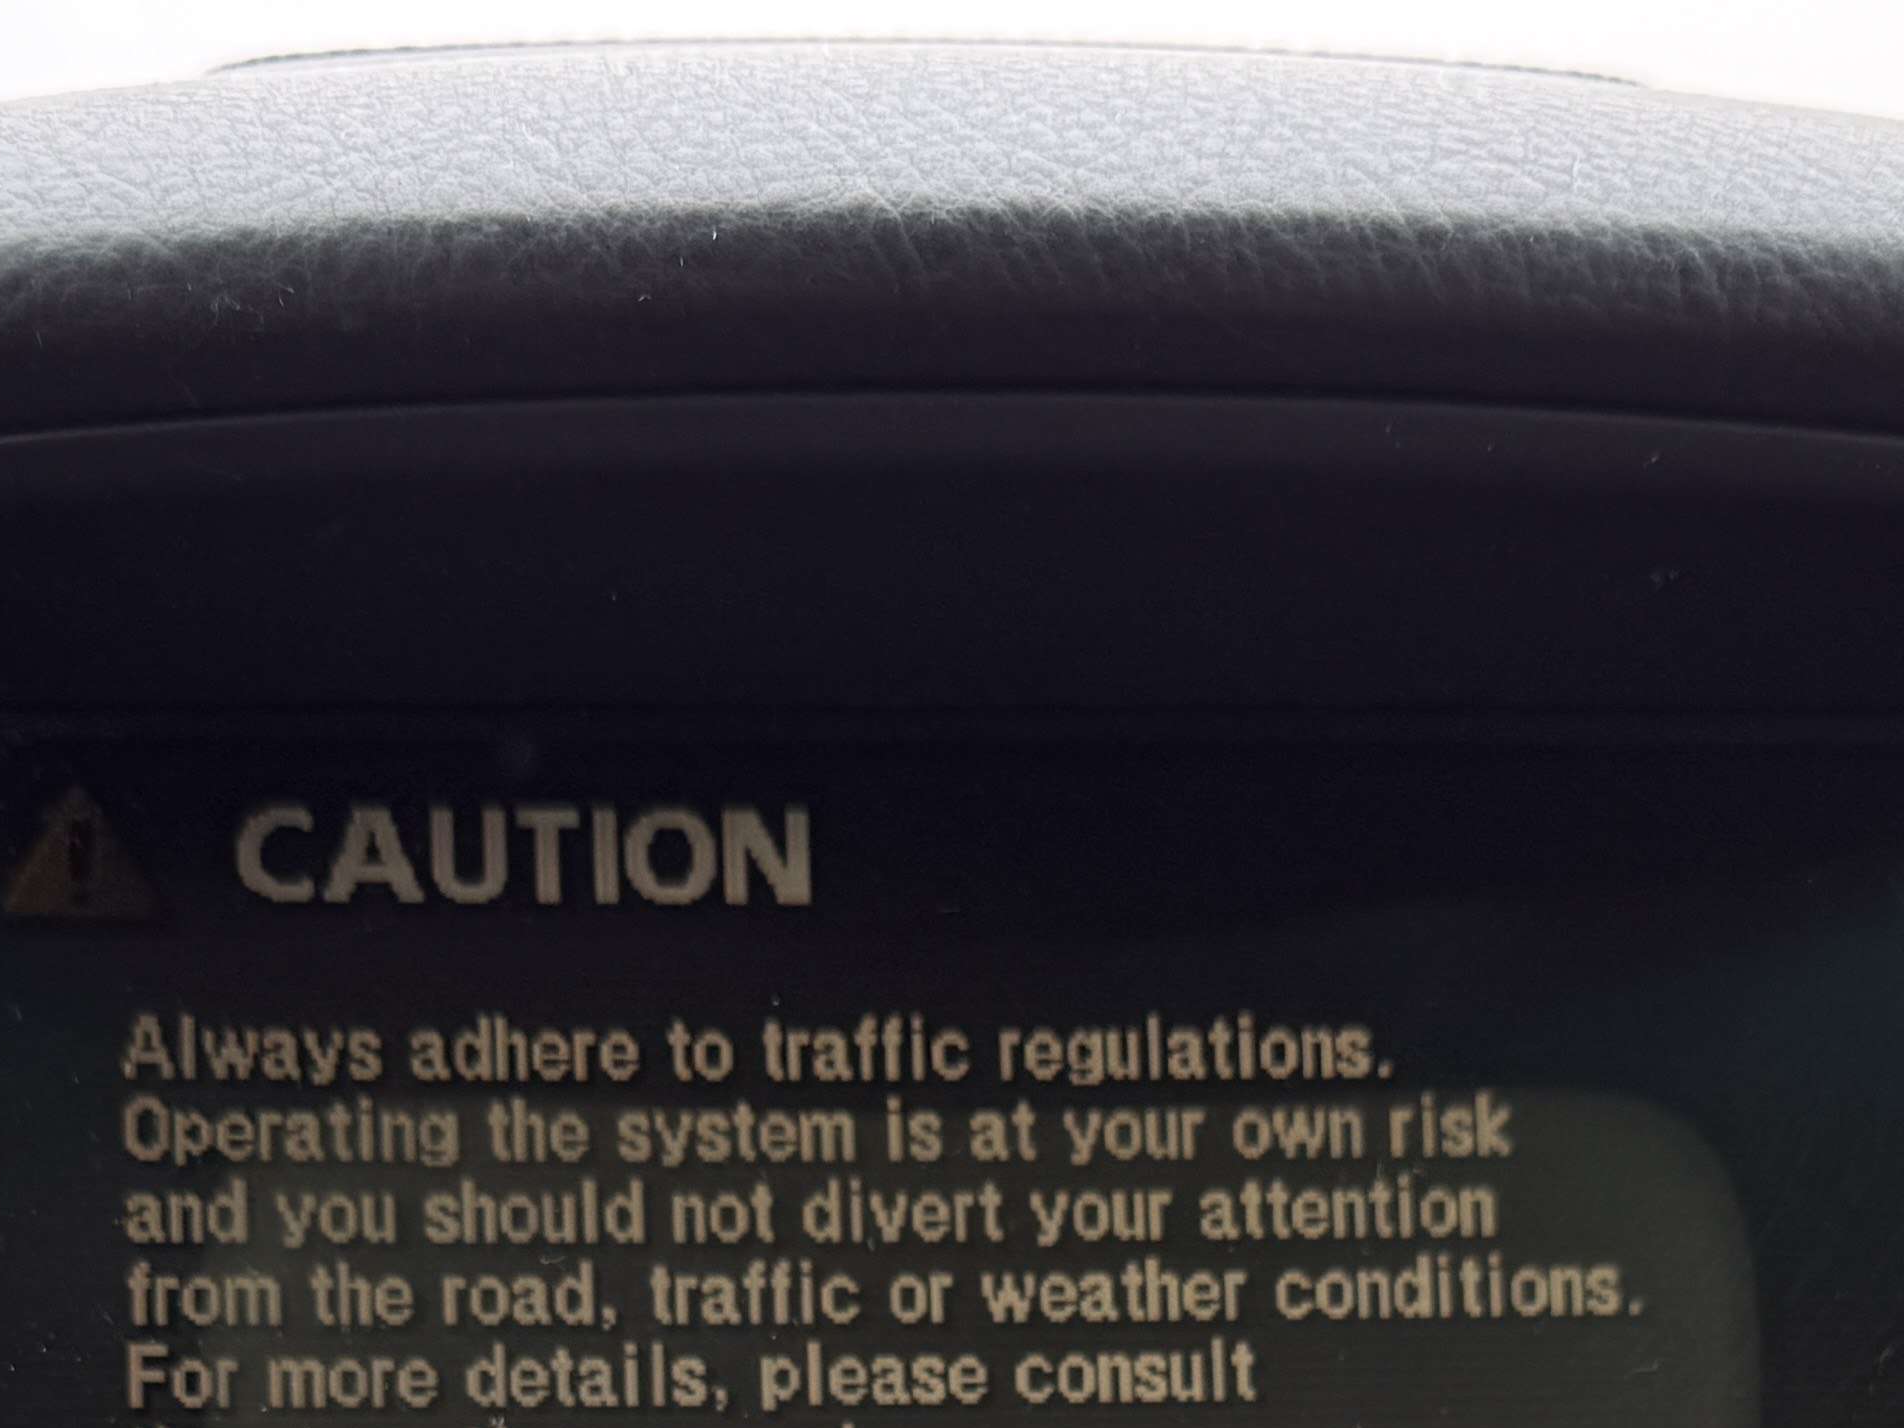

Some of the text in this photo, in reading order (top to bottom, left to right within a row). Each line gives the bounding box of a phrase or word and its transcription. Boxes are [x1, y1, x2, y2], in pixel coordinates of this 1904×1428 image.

[233, 805, 812, 906] CAUTION
[124, 1011, 1394, 1086] Always adhere to traffic regulations.
[122, 1090, 1513, 1169] Operating the system is at your own risk
[124, 1175, 1498, 1249] and you should not divert your attention
[128, 1253, 1644, 1331] from the road, traffic or weather conditions.
[125, 1336, 1257, 1411] For more details, please consult
